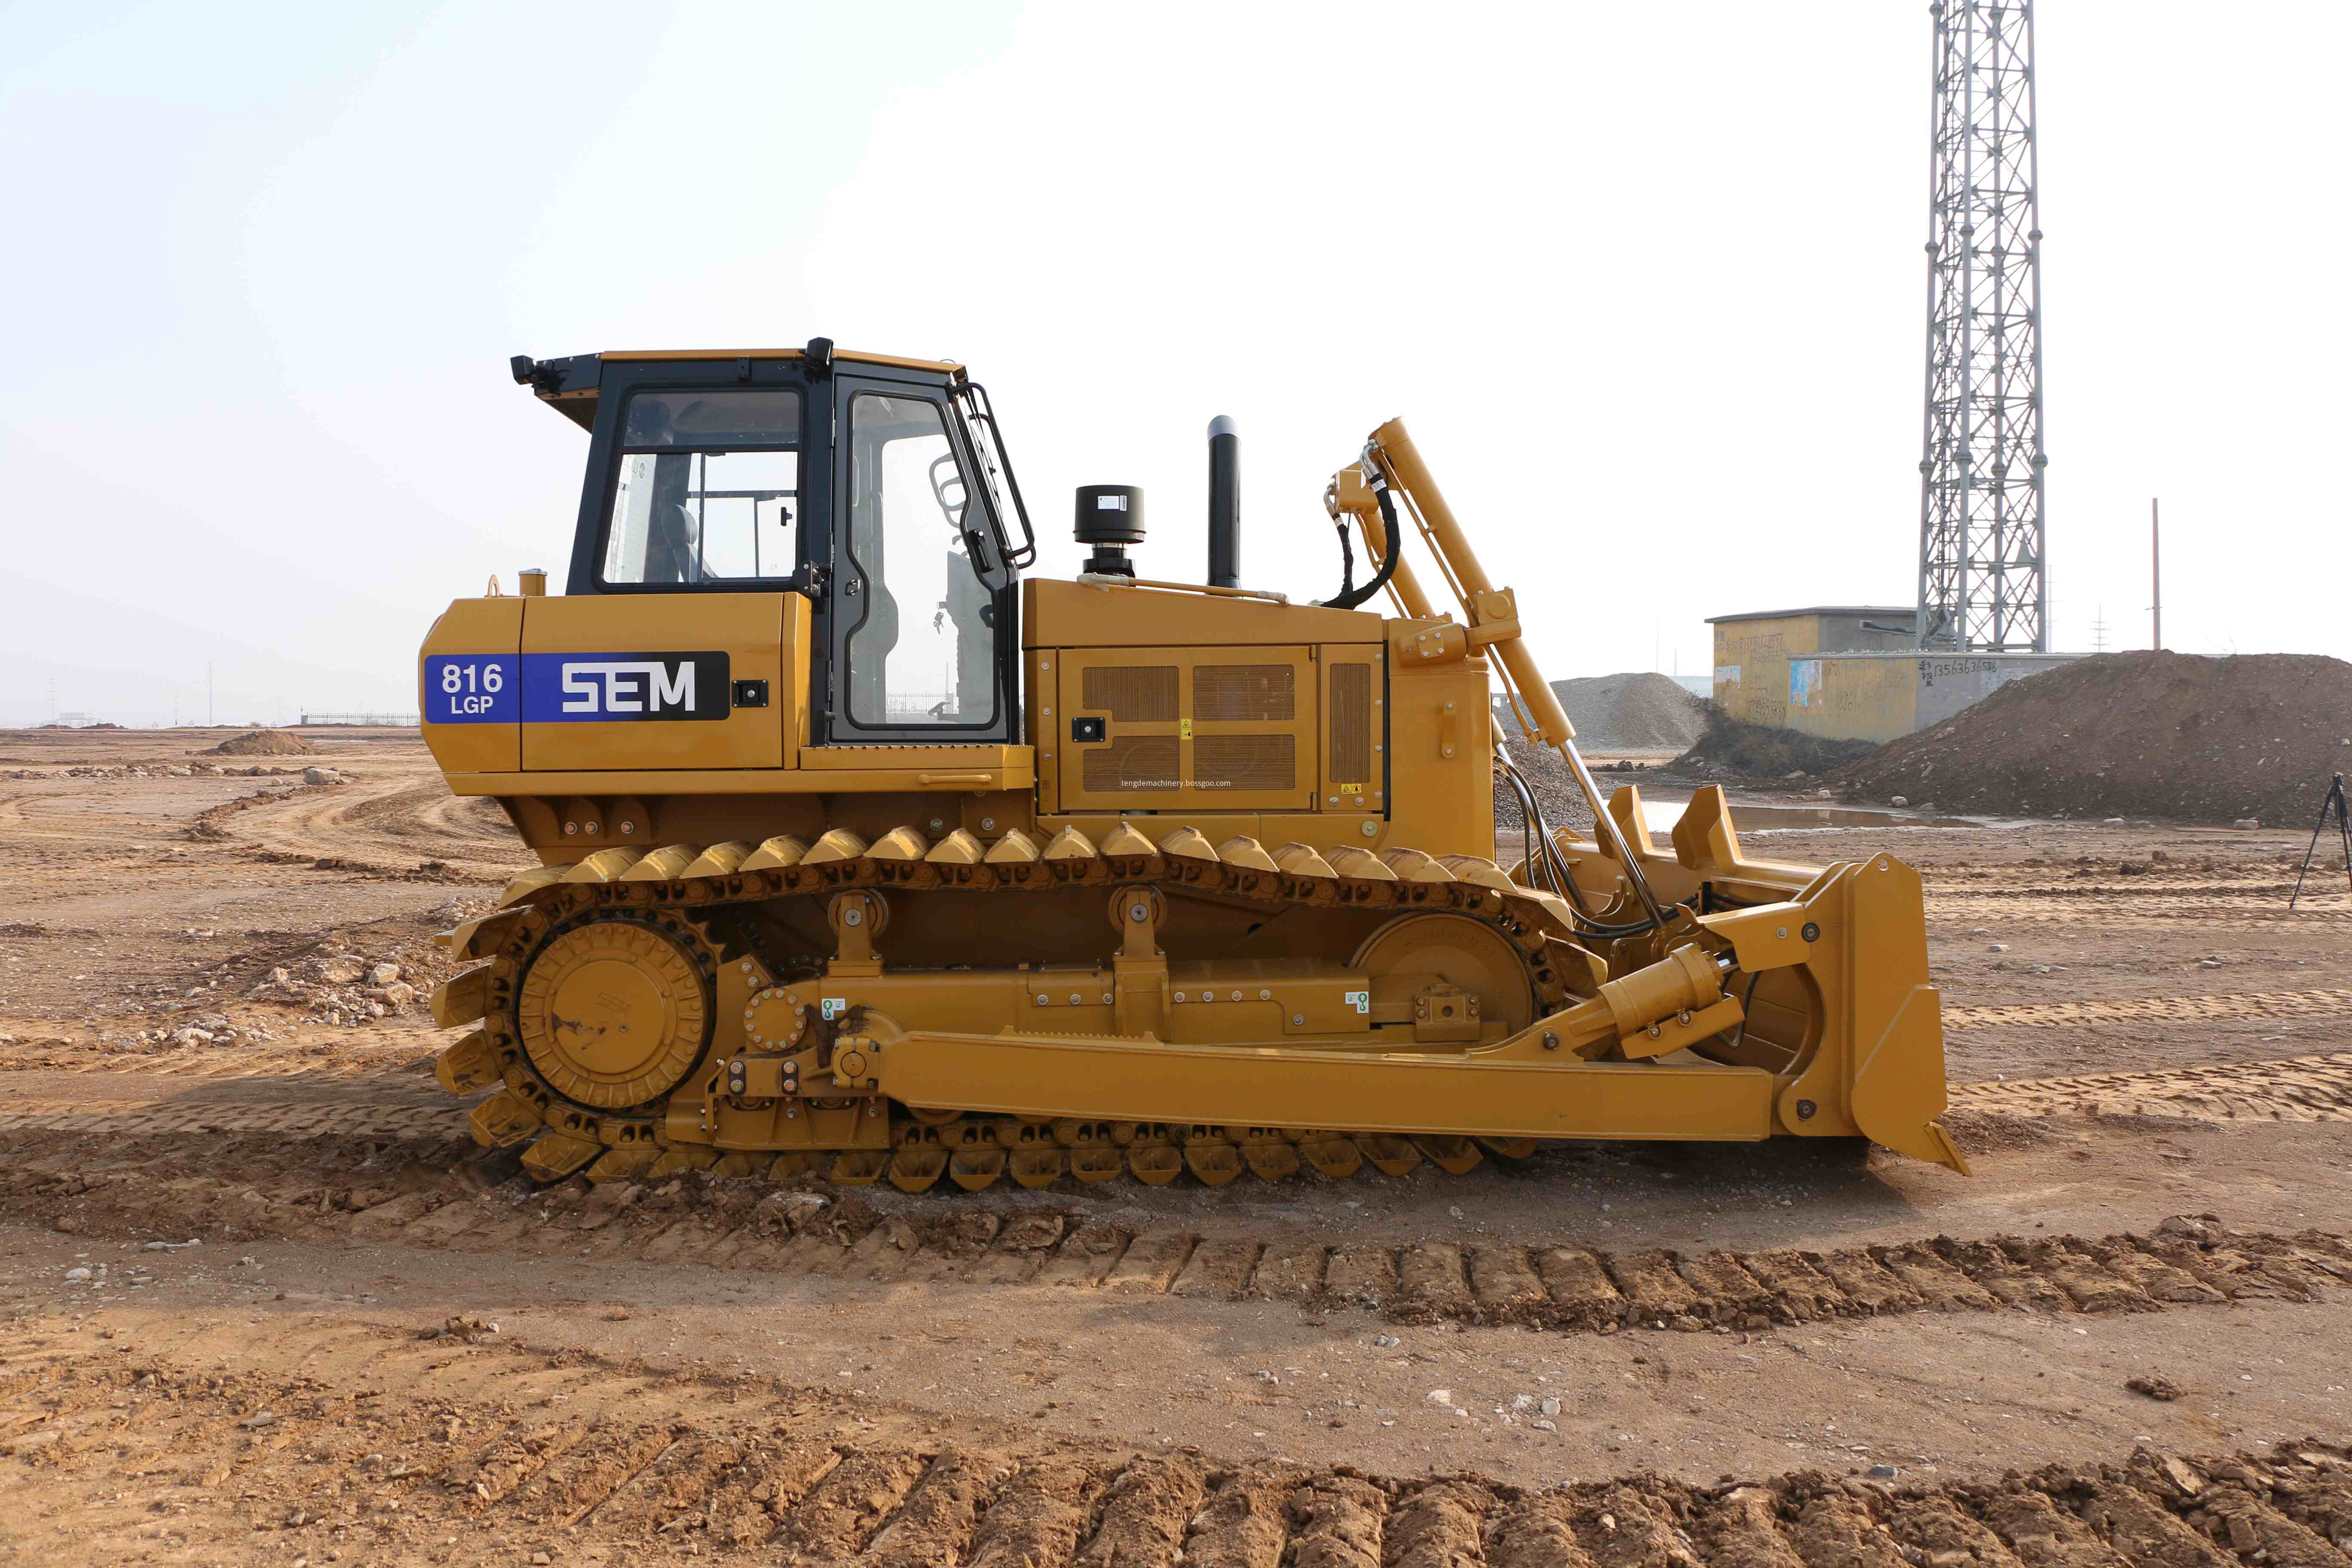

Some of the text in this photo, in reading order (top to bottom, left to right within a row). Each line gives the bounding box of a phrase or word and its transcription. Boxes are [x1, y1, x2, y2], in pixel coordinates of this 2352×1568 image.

[442, 664, 502, 693] 816
[1934, 659, 1997, 677] 13563636586
[562, 662, 695, 713] SEM
[451, 696, 493, 714] LGP
